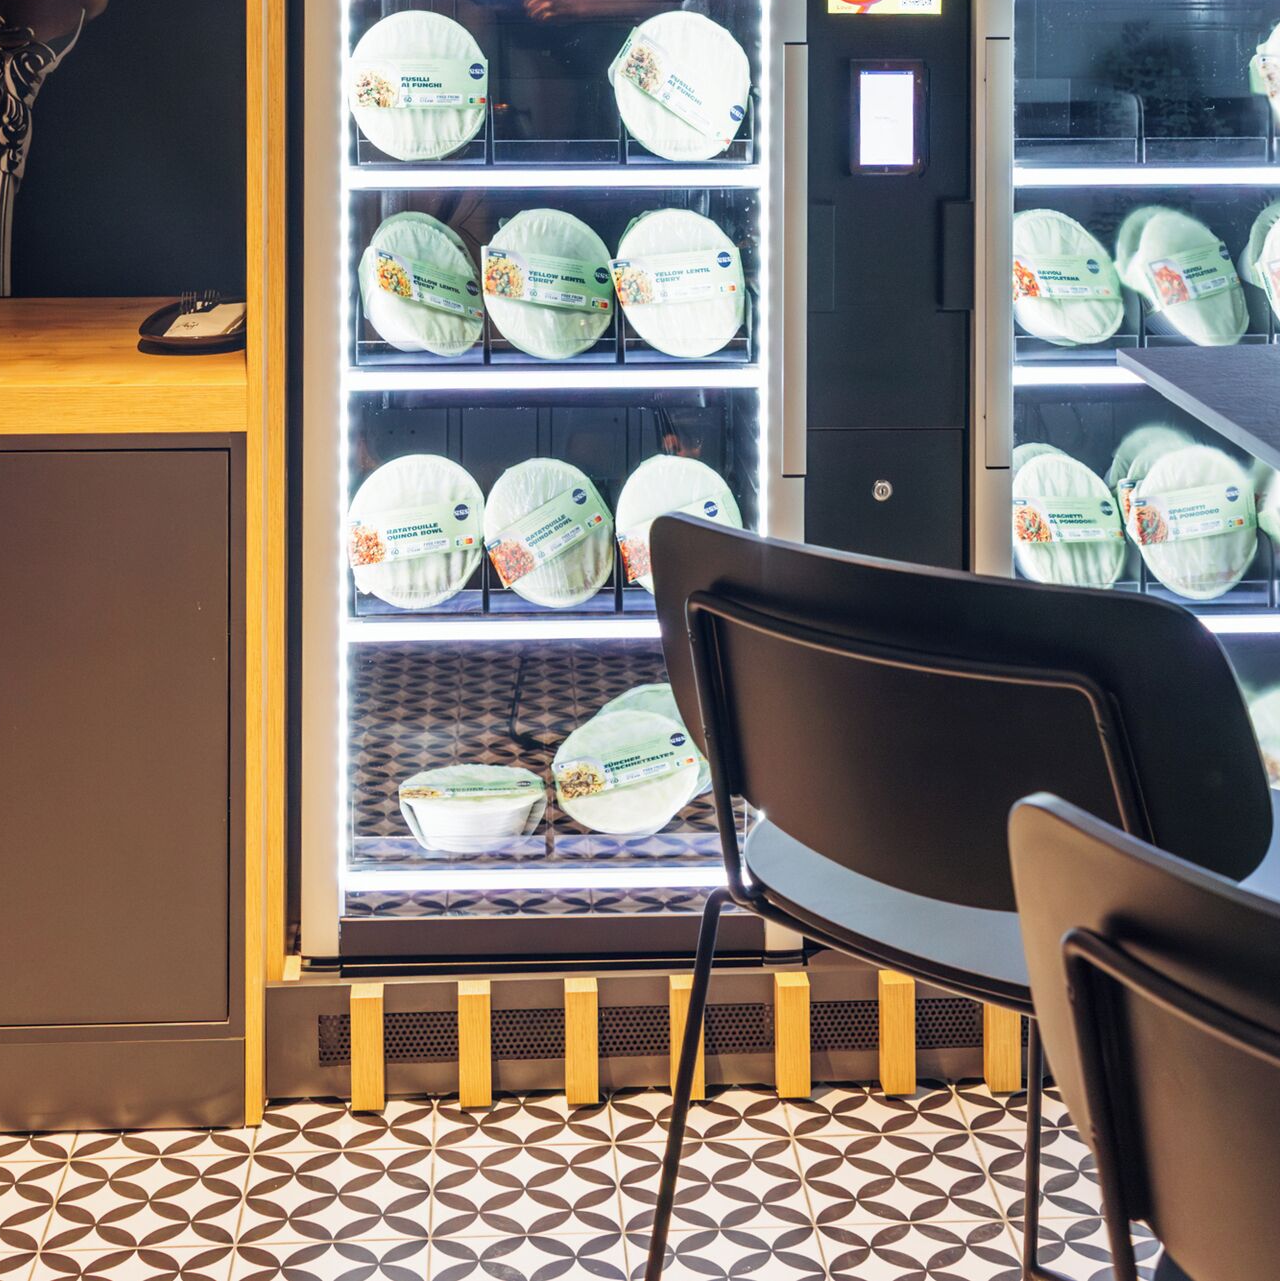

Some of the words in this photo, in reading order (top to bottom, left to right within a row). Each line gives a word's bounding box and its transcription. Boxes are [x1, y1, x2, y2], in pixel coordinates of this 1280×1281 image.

[528, 270, 559, 280] YELLOW
[560, 275, 586, 285] LENTIL
[528, 276, 554, 285] CURRY
[1168, 504, 1206, 515] SPAGHETTI
[1180, 508, 1220, 519] POMODORO
[386, 522, 439, 535] RATATOUILLE
[525, 513, 567, 542] RATATOUILLE
[528, 529, 554, 548] QUINOA
[554, 518, 572, 531] BOWL
[387, 531, 418, 541] QUINOA
[420, 528, 444, 536] BOWL
